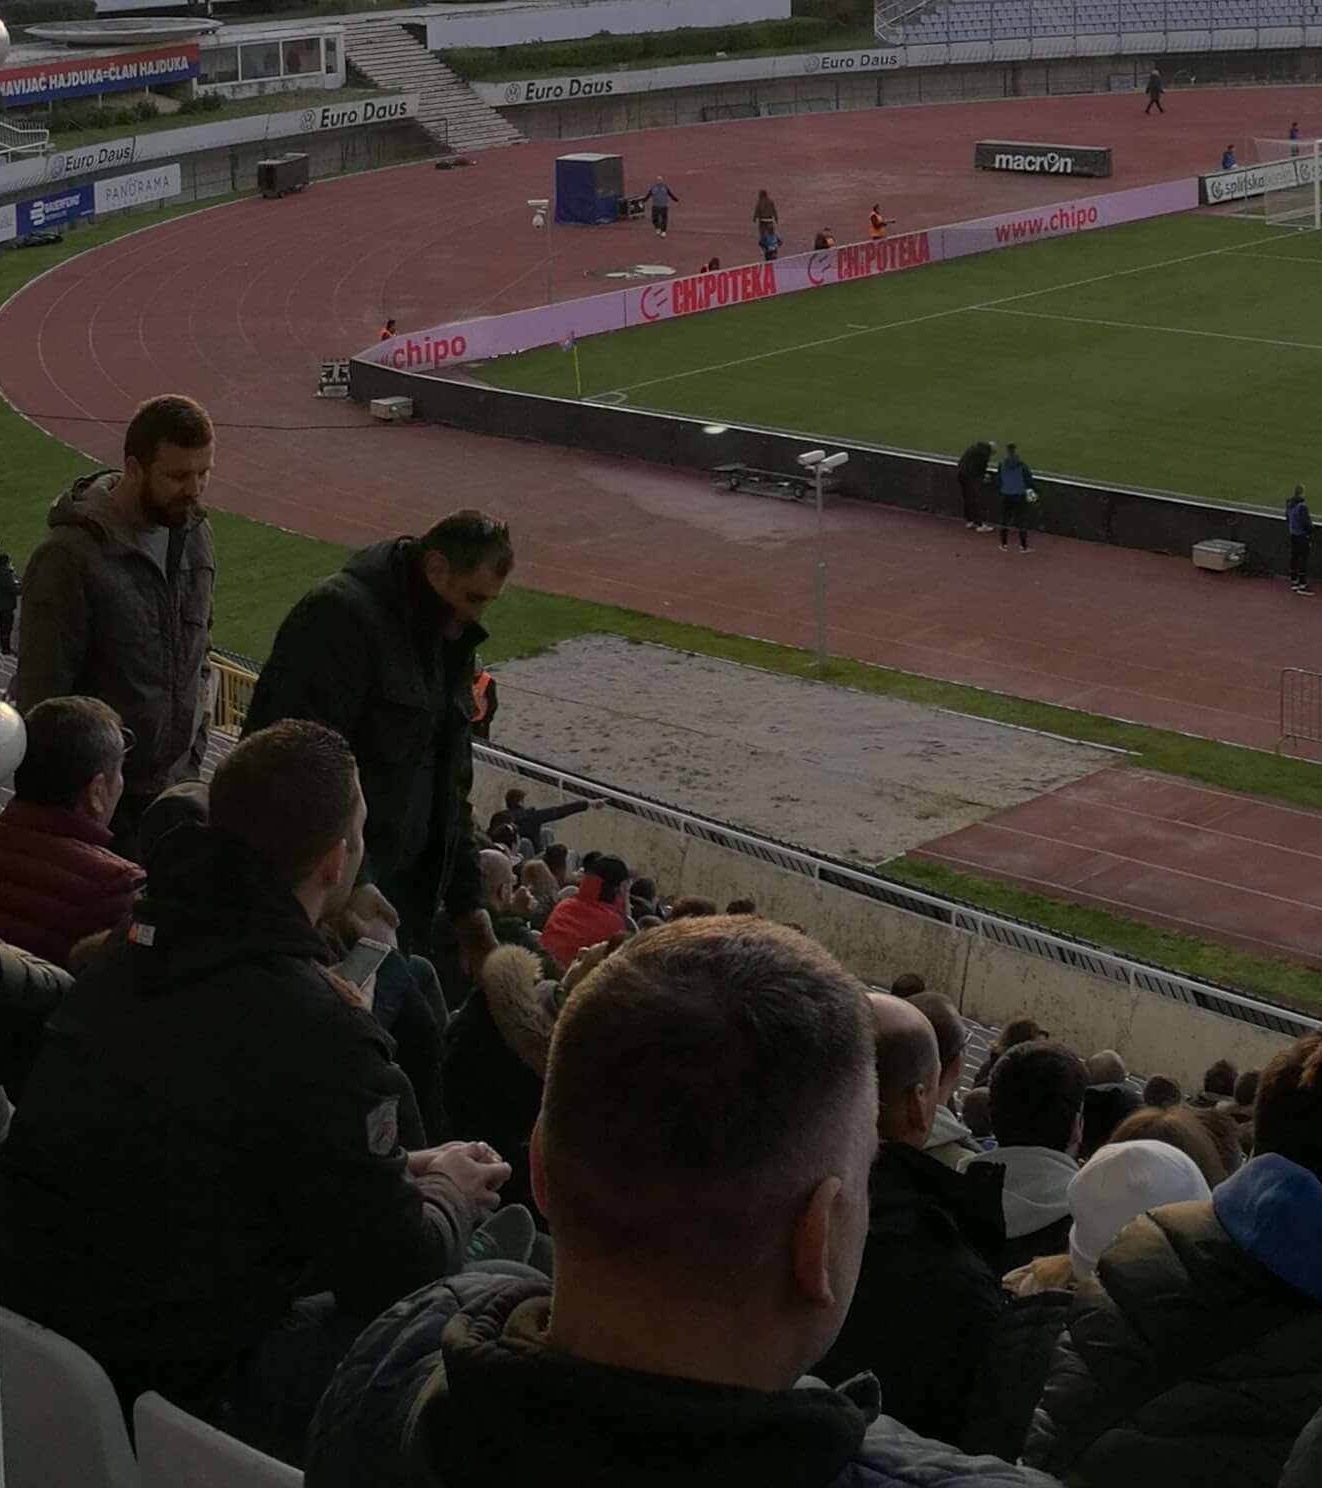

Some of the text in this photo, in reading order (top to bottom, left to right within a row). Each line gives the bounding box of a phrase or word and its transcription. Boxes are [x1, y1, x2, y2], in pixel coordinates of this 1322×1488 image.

[139, 55, 189, 76] HAJDUKA
[821, 54, 897, 69] Euro Daus
[525, 79, 613, 100] Euro Daus
[319, 100, 408, 129] Euro Daus
[64, 147, 131, 172] Euro Daus
[994, 152, 1073, 174] macron
[105, 176, 170, 201] PANORAMA
[996, 207, 1098, 243] www.chipo
